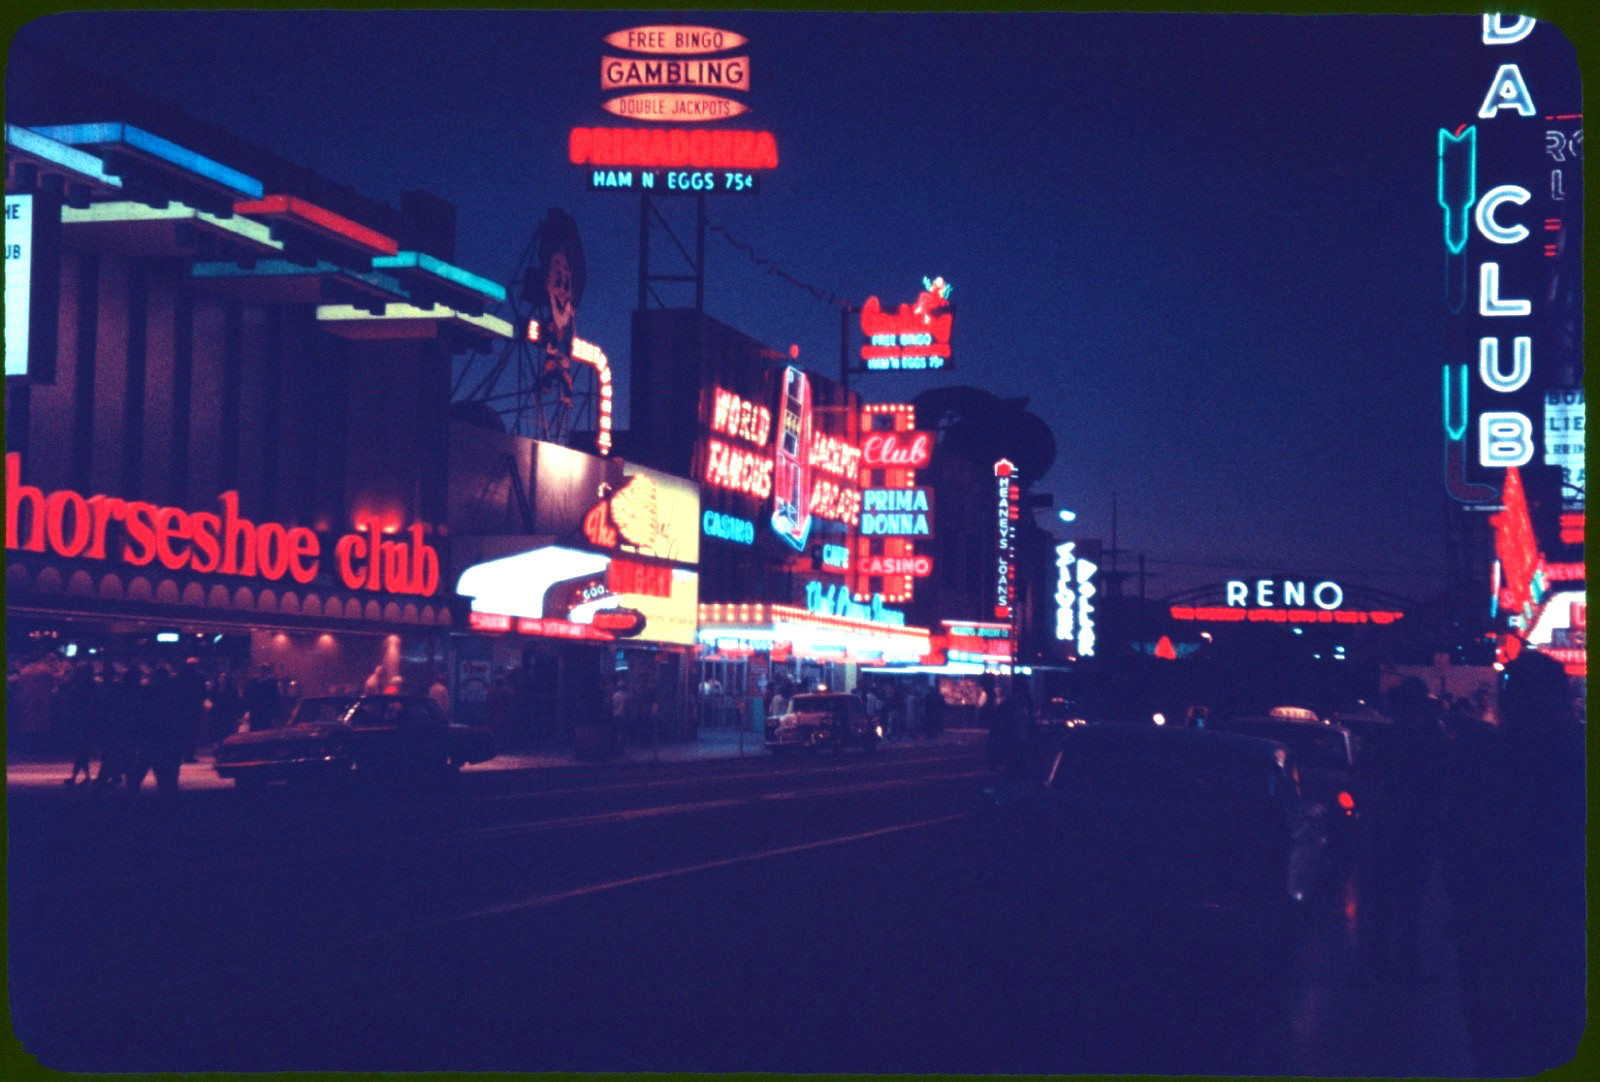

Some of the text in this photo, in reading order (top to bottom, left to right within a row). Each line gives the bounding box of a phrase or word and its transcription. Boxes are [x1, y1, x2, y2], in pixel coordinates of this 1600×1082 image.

[628, 31, 724, 48] FREE BINGO
[606, 61, 743, 84] GAMBLING
[619, 99, 731, 116] DOUBLE JACKPOTS
[593, 170, 632, 187] HAM
[668, 172, 714, 189] EGGS
[1475, 184, 1535, 468] CLUB
[872, 333, 932, 346] FREE BINGO
[868, 358, 890, 370] HAM
[901, 357, 927, 370] EGGS
[712, 387, 771, 448] WORLD
[863, 435, 928, 466] Club
[704, 440, 774, 498] FAMOUS
[863, 490, 929, 511] PRIMA
[6, 452, 440, 597] horseshoe club
[703, 510, 754, 545] CASINO
[862, 513, 929, 534] DONNA
[858, 557, 931, 575] CASINO
[1226, 579, 1344, 610] RENO
